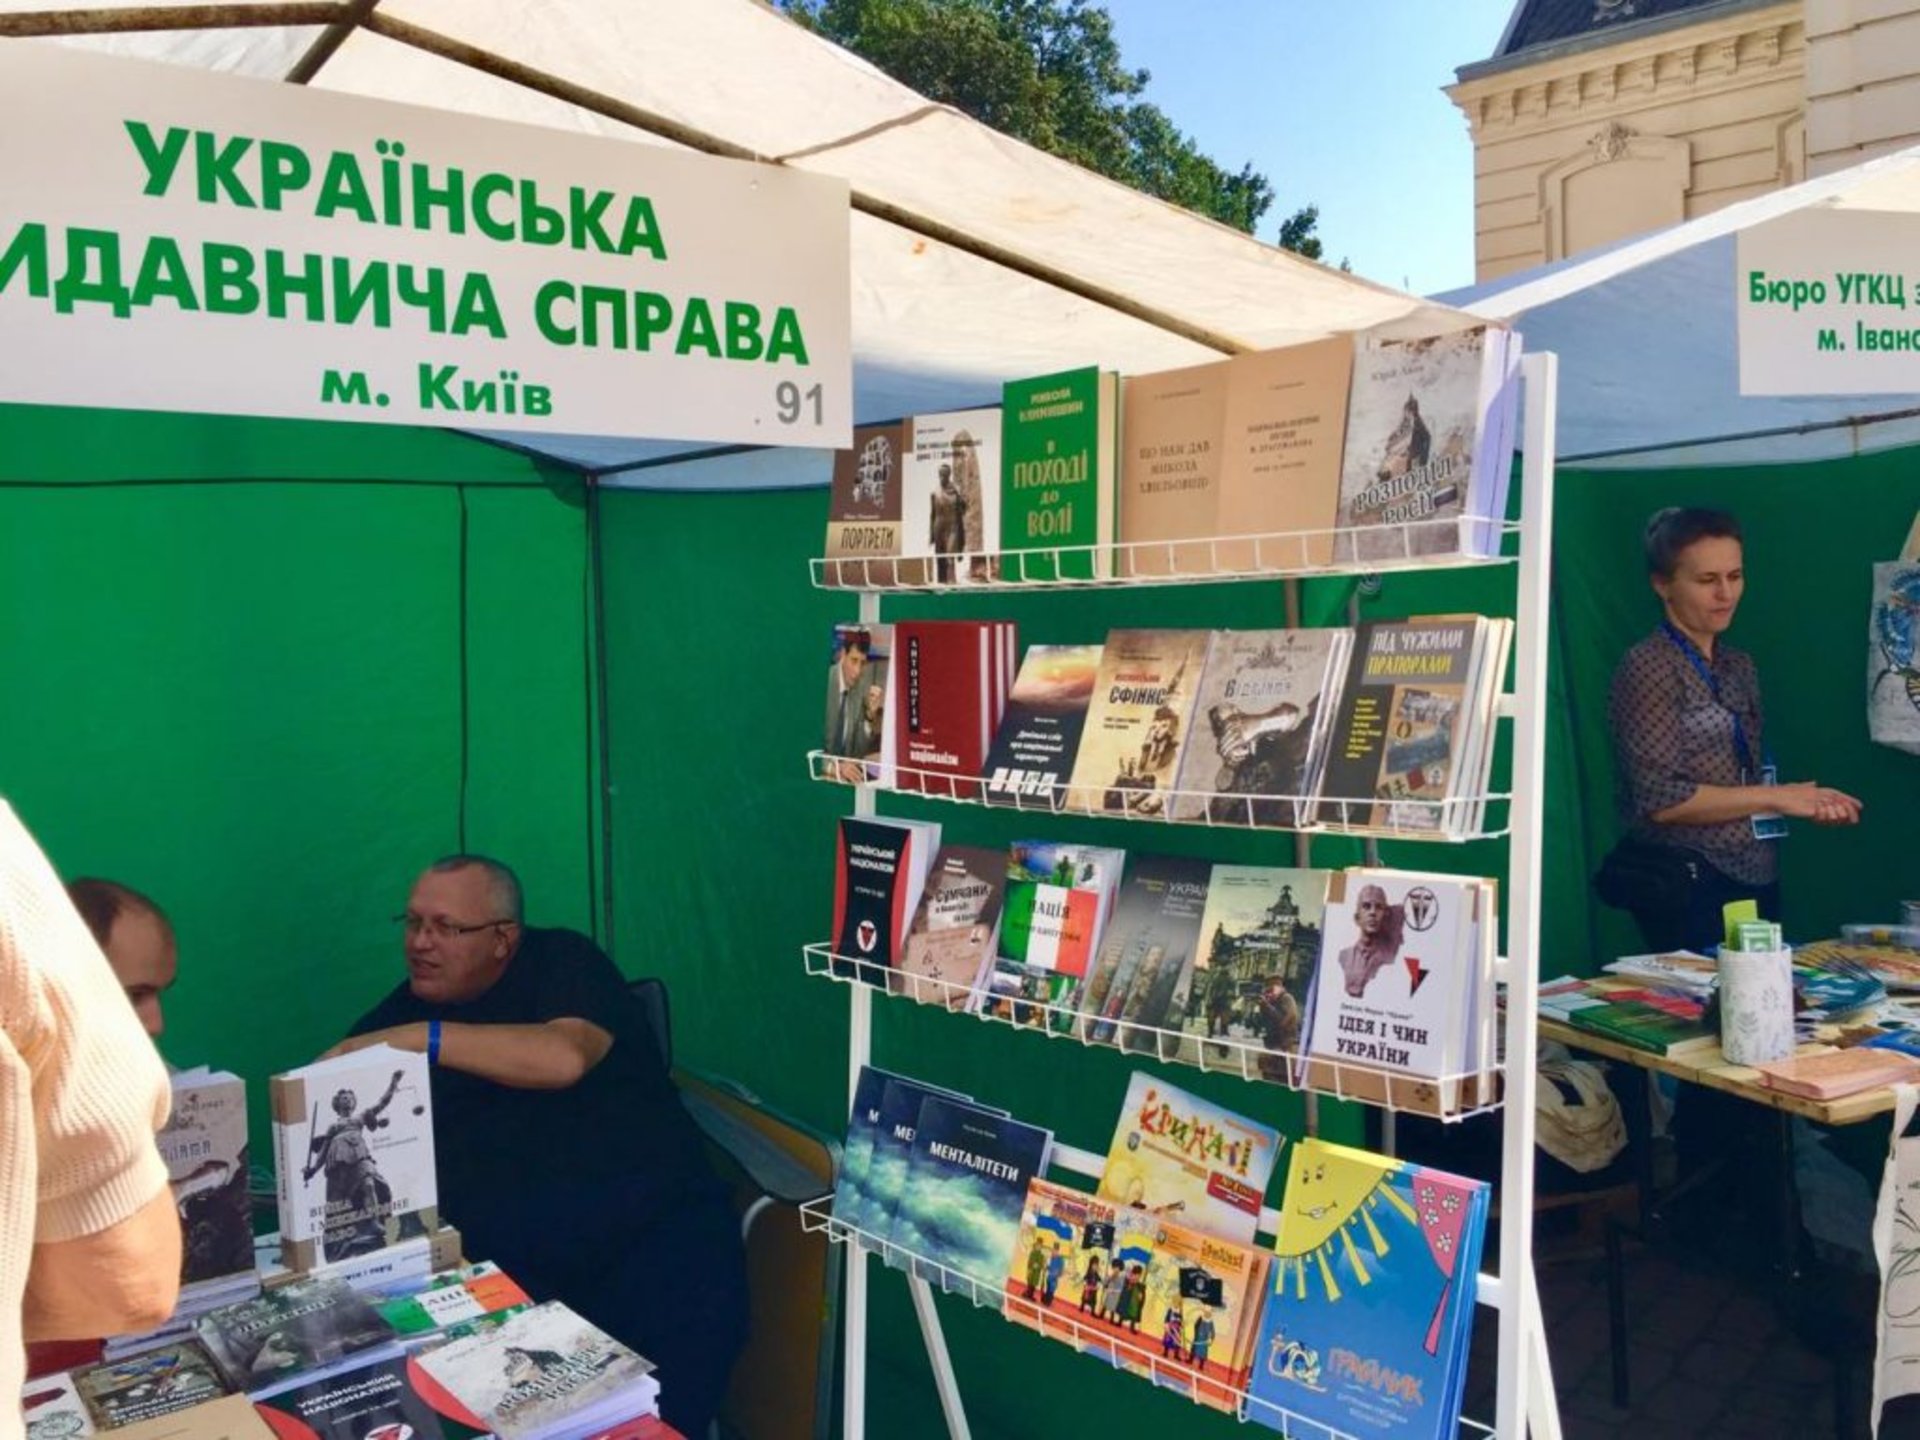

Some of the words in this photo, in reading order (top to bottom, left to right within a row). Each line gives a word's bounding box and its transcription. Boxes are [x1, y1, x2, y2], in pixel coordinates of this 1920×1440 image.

[124, 120, 667, 260] УКРАЇНСЬКА
[1749, 271, 1826, 311] Бюро
[1836, 273, 1905, 309] УГКЦ
[534, 281, 809, 366] СПРАВА
[1818, 329, 1845, 350] м.
[321, 370, 390, 406] м.
[419, 363, 553, 417] Київ
[775, 381, 824, 426] 91
[1014, 448, 1087, 489] ПОХОДІ
[1355, 455, 1452, 511] РОЗПОДІЛ
[1027, 502, 1073, 537] ВОЛІ
[1338, 1014, 1375, 1035] ІДЕЯ
[1379, 1021, 1387, 1038] І
[1392, 1023, 1429, 1046] ЧИН
[1337, 1037, 1410, 1067] УКРАЇНИ
[929, 1140, 1020, 1183] МЕНТАЛІТЕТИ
